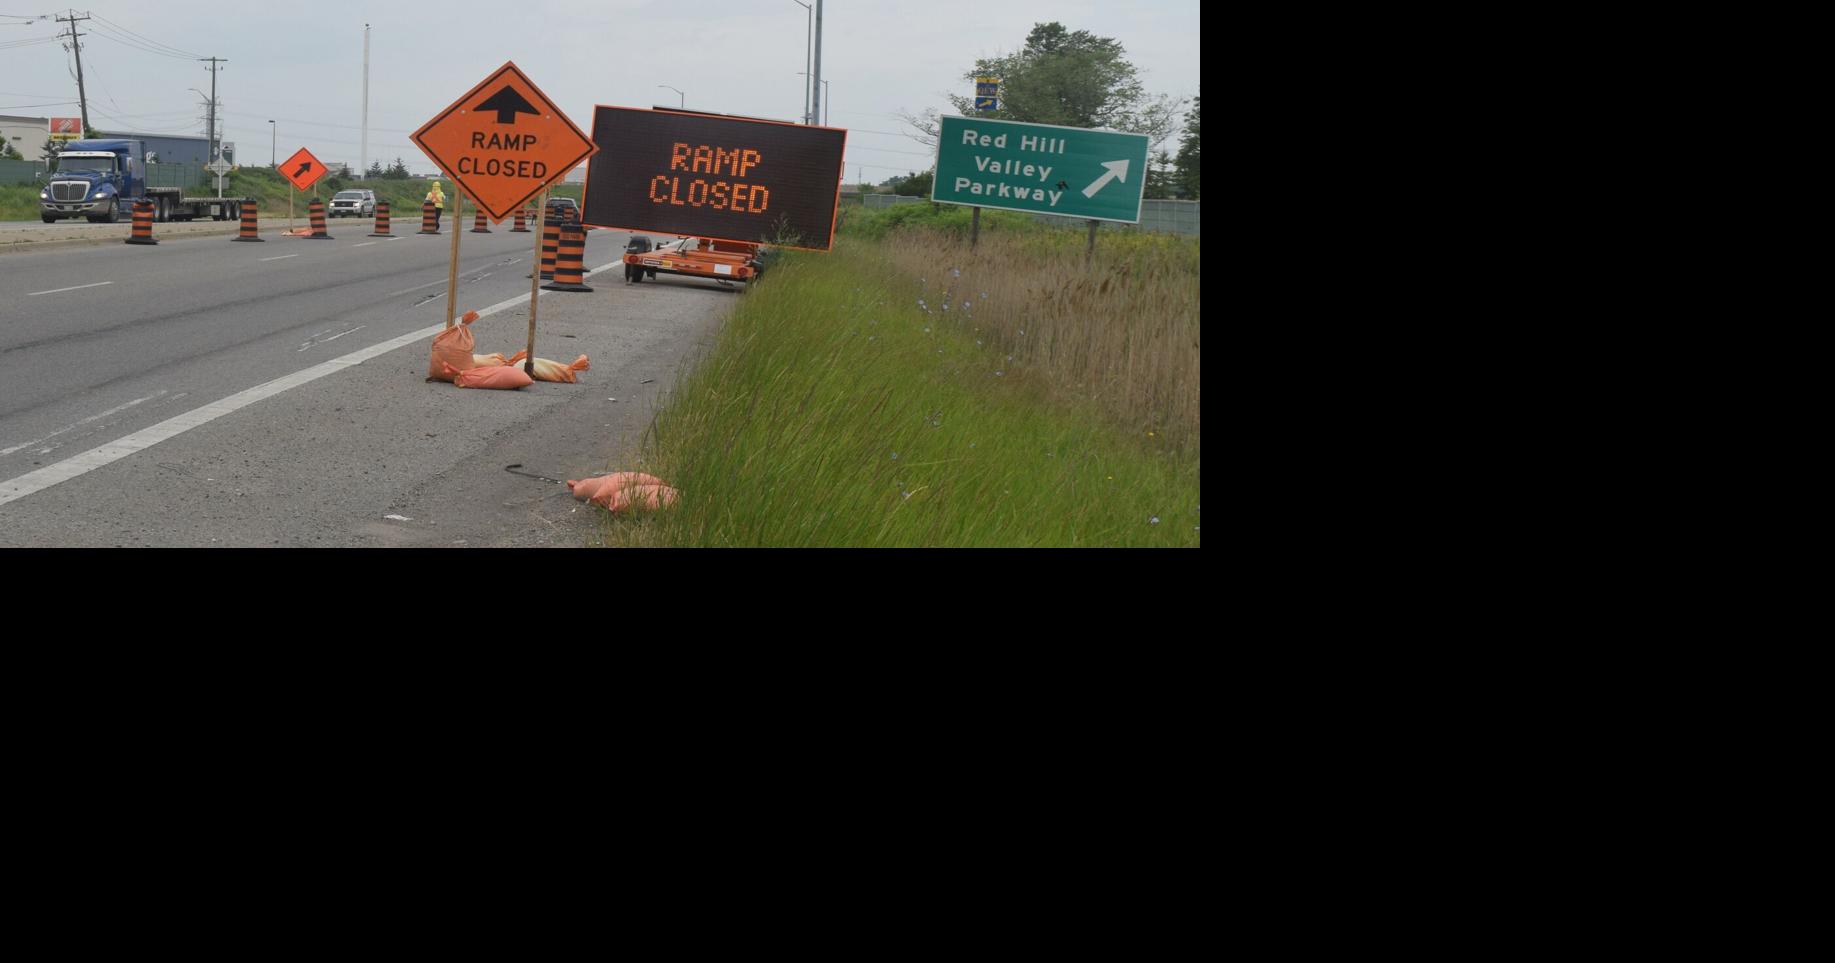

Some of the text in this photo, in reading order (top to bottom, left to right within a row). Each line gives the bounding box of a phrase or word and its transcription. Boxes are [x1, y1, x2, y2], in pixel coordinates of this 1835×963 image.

[471, 131, 537, 151] RAMP
[962, 129, 1065, 154] Red Hill
[458, 157, 547, 179] CLOSED
[671, 142, 761, 177] RAMP
[975, 155, 1053, 182] Valley
[649, 175, 769, 212] CLOSED
[954, 177, 1063, 206] Parkway
